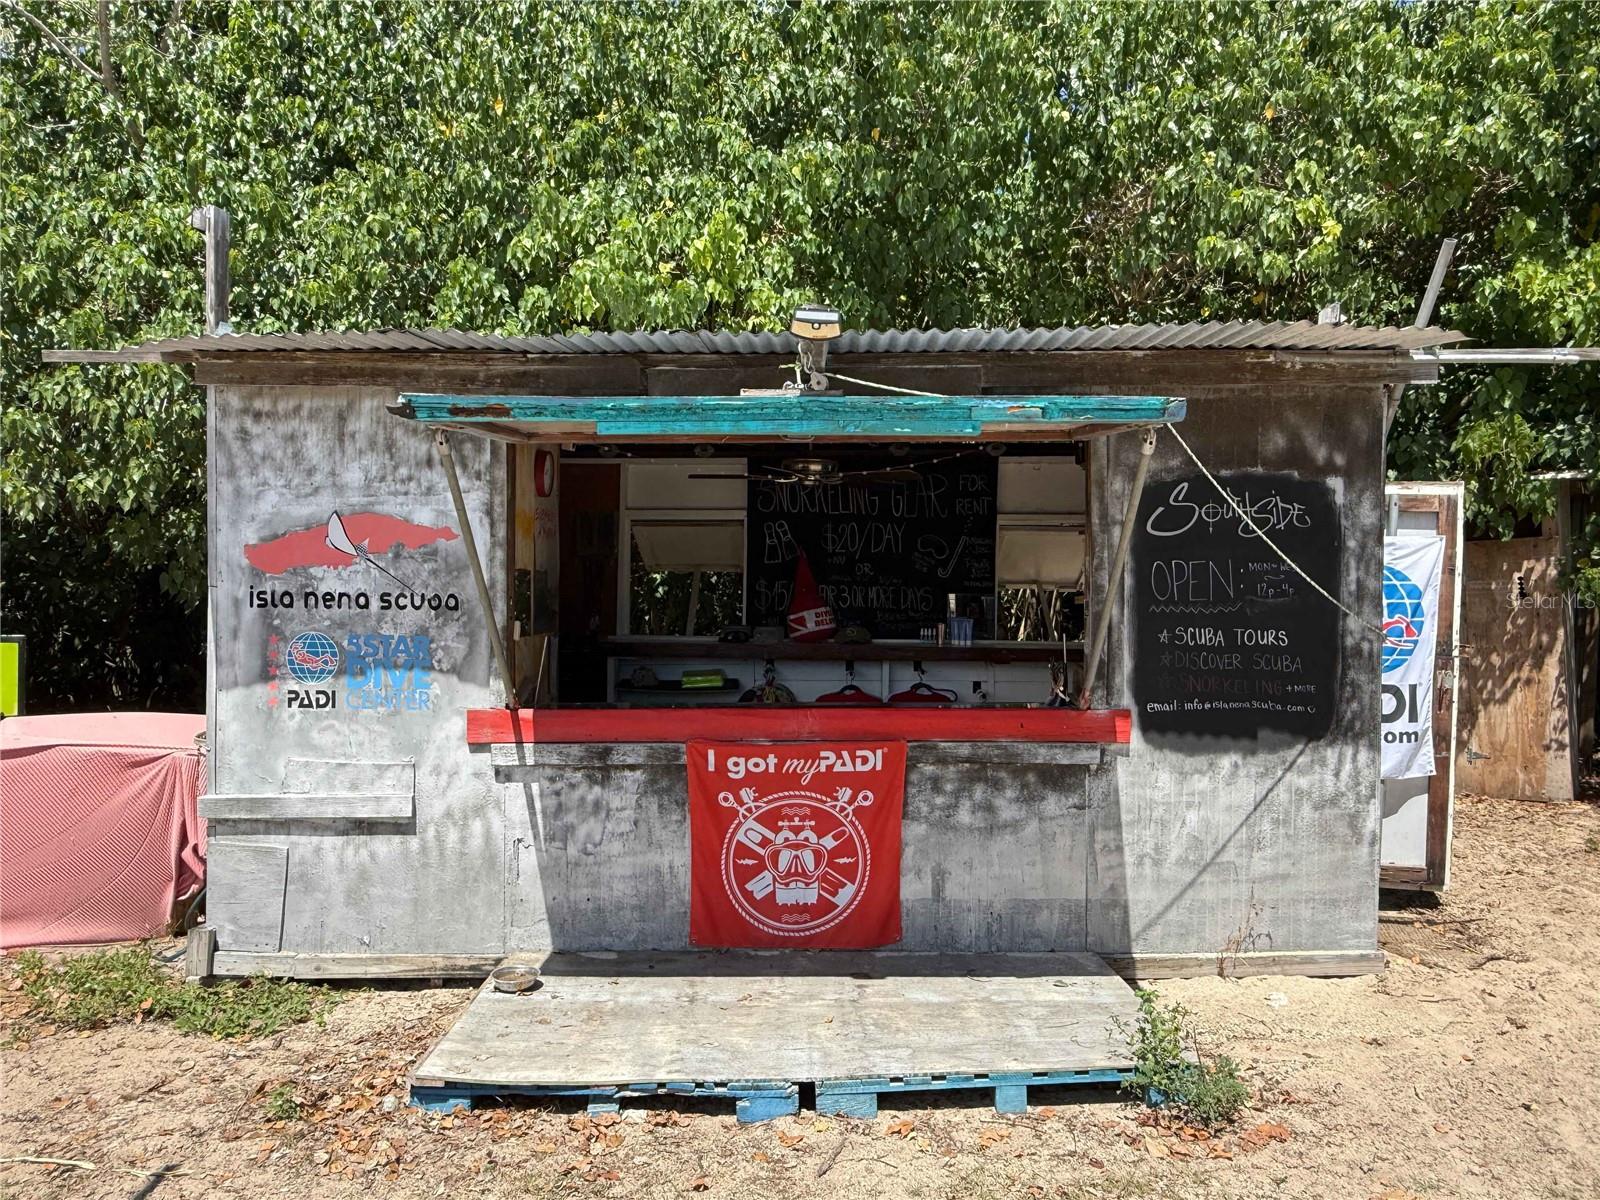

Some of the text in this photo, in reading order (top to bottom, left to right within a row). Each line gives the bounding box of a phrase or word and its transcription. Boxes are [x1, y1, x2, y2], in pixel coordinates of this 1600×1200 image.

[959, 473, 992, 493] FOR
[955, 496, 993, 517] RENT
[855, 562, 875, 576] OR
[249, 585, 294, 609] isla
[304, 592, 370, 610] nena
[839, 584, 851, 608] 3
[868, 585, 897, 609] MORE
[900, 585, 934, 611] DAYS
[1174, 626, 1289, 647] SCUBA TOURS
[346, 656, 433, 689] DIVE
[1174, 650, 1302, 673] DISCOVER SCUBA
[287, 690, 336, 709] PADI
[1147, 699, 1182, 713] email:
[1381, 684, 1418, 723] DI
[708, 749, 715, 772] I
[726, 753, 778, 779] got
